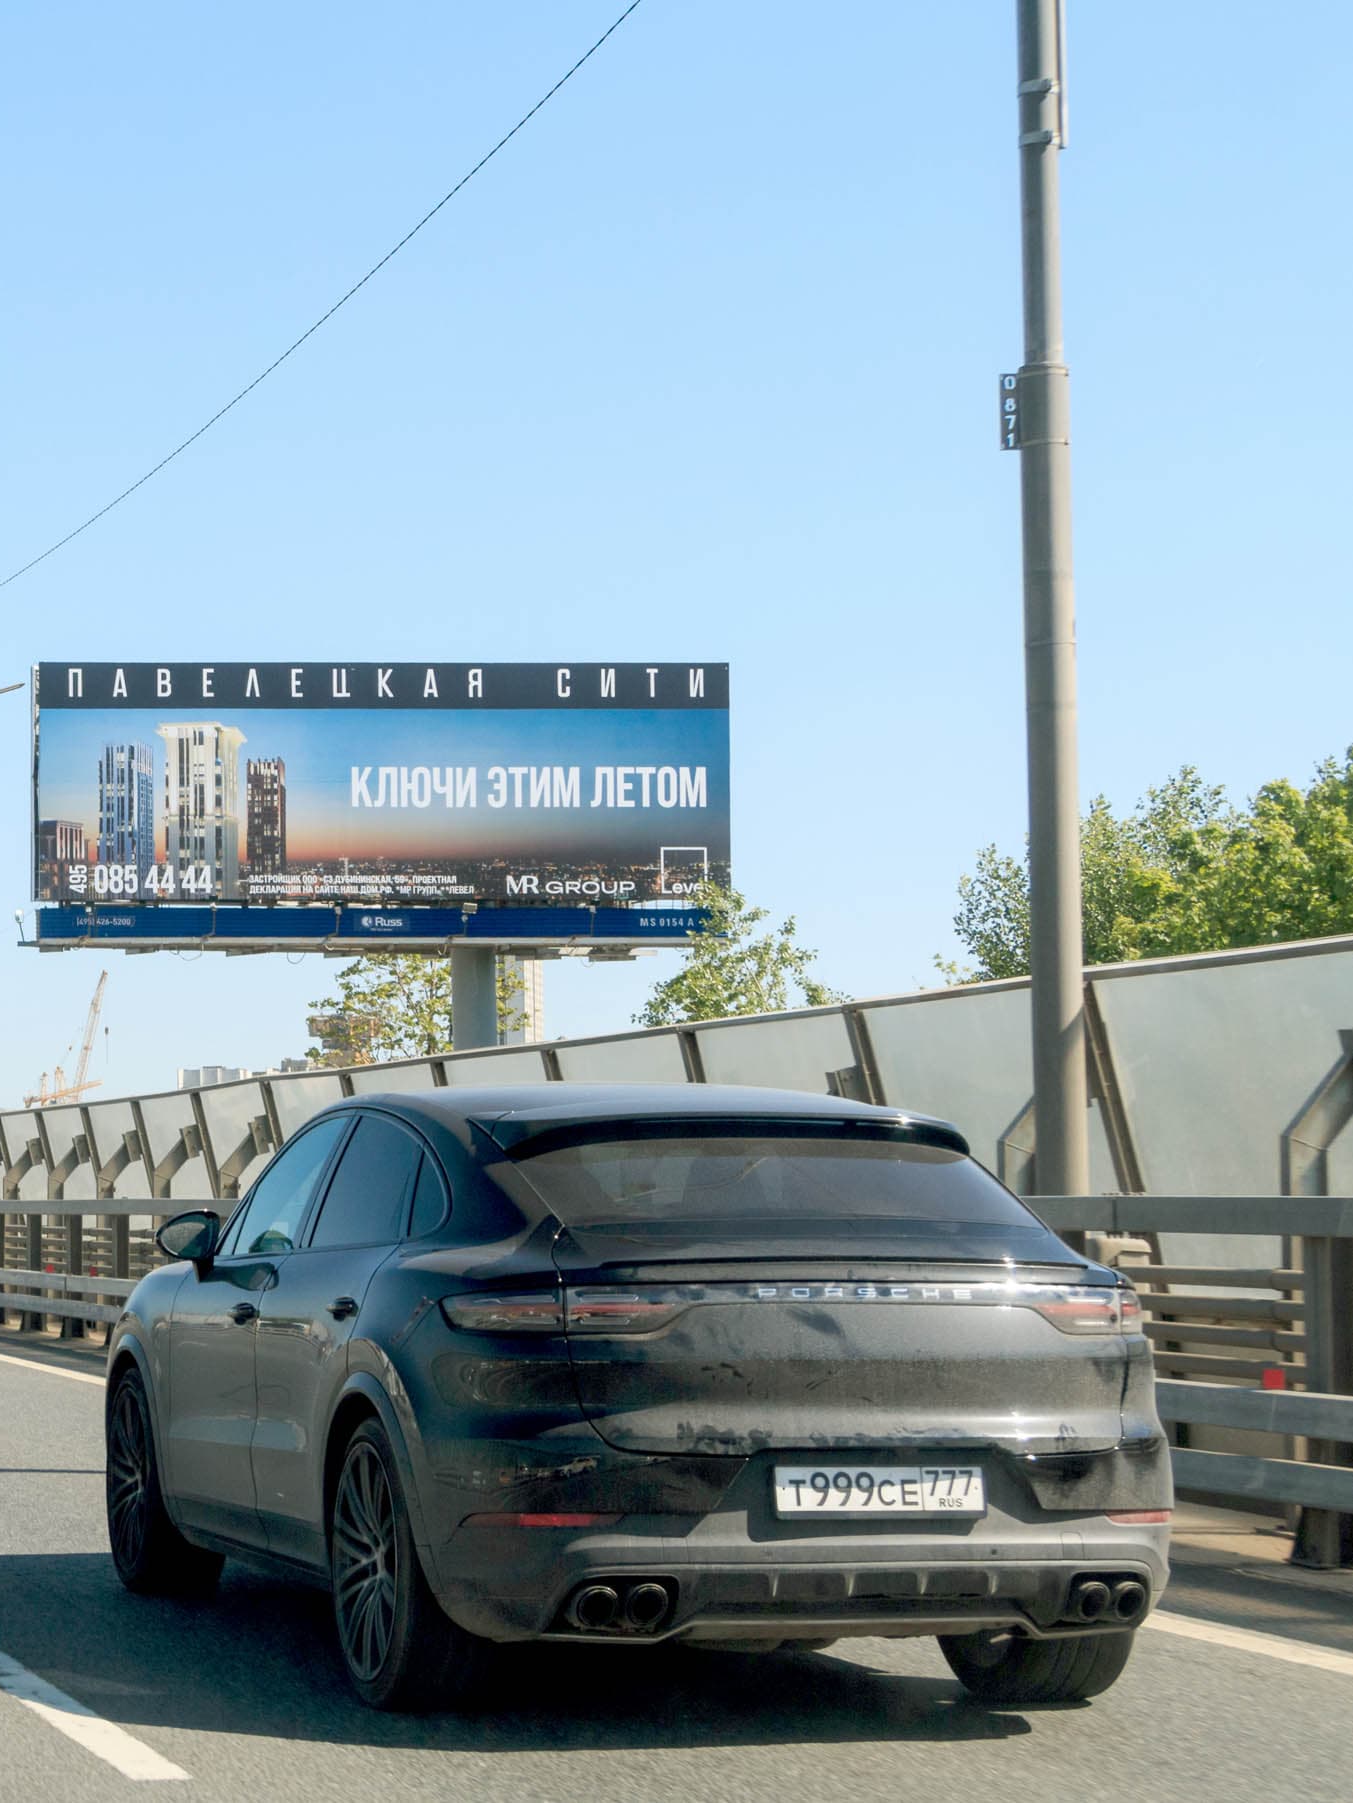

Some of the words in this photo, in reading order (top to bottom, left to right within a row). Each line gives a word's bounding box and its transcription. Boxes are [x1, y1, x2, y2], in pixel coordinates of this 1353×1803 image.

[1004, 376, 1016, 447] 0871
[68, 668, 483, 698] ПАВЕЛЕЦКАЯ
[557, 668, 704, 698] СИТИ
[351, 766, 477, 808] КЛЮЧИ
[487, 766, 580, 808] ЭТИМ
[590, 766, 707, 808] ЛЕТОМ
[69, 865, 87, 893] 495
[94, 864, 138, 894] 085
[144, 865, 176, 894] 44
[181, 865, 213, 894] 44
[506, 875, 539, 895] MR
[545, 881, 636, 894] GROUP
[375, 916, 403, 927] Russ
[640, 918, 656, 927] MS
[660, 918, 684, 927] 0154
[758, 1287, 972, 1300] PORSCHE
[924, 1469, 973, 1496] 777
[939, 1497, 963, 1508] RUS
